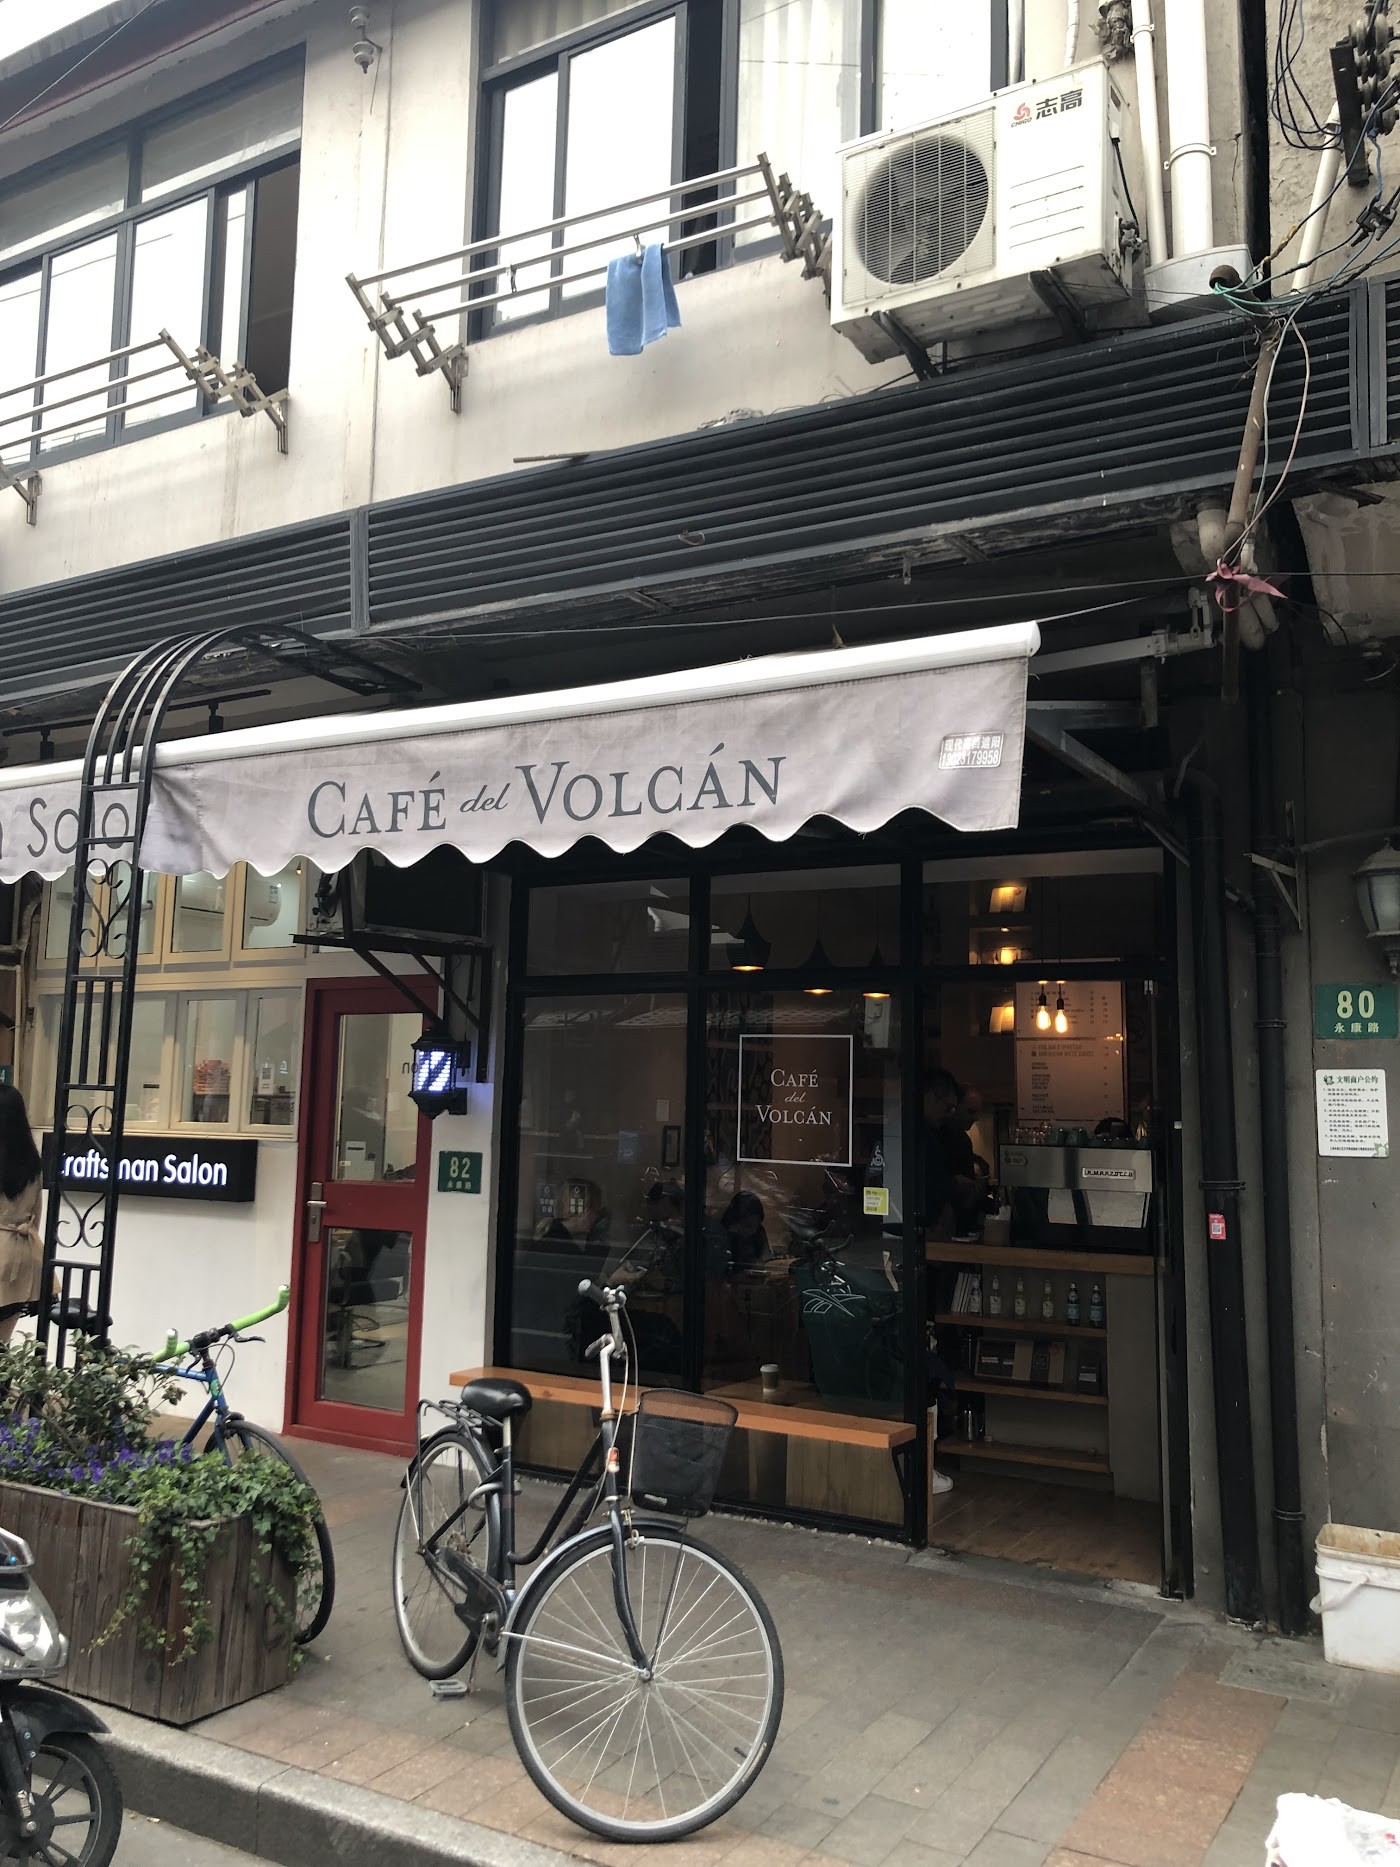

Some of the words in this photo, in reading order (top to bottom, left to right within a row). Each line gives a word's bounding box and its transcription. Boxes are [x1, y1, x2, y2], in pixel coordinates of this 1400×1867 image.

[1036, 88, 1083, 120] 志高
[308, 770, 447, 838] CAFÉ
[459, 782, 511, 813] del
[515, 742, 787, 825] VOLCÁN
[1336, 990, 1375, 1019] 80
[1334, 1022, 1380, 1034] 永康路
[770, 1068, 819, 1088] CAFÉ
[1336, 1075, 1379, 1084] 文明商户公约
[784, 1091, 807, 1103] del
[755, 1105, 833, 1125] VOLCÁN
[163, 1153, 228, 1186] Salon
[449, 1156, 471, 1179] 82
